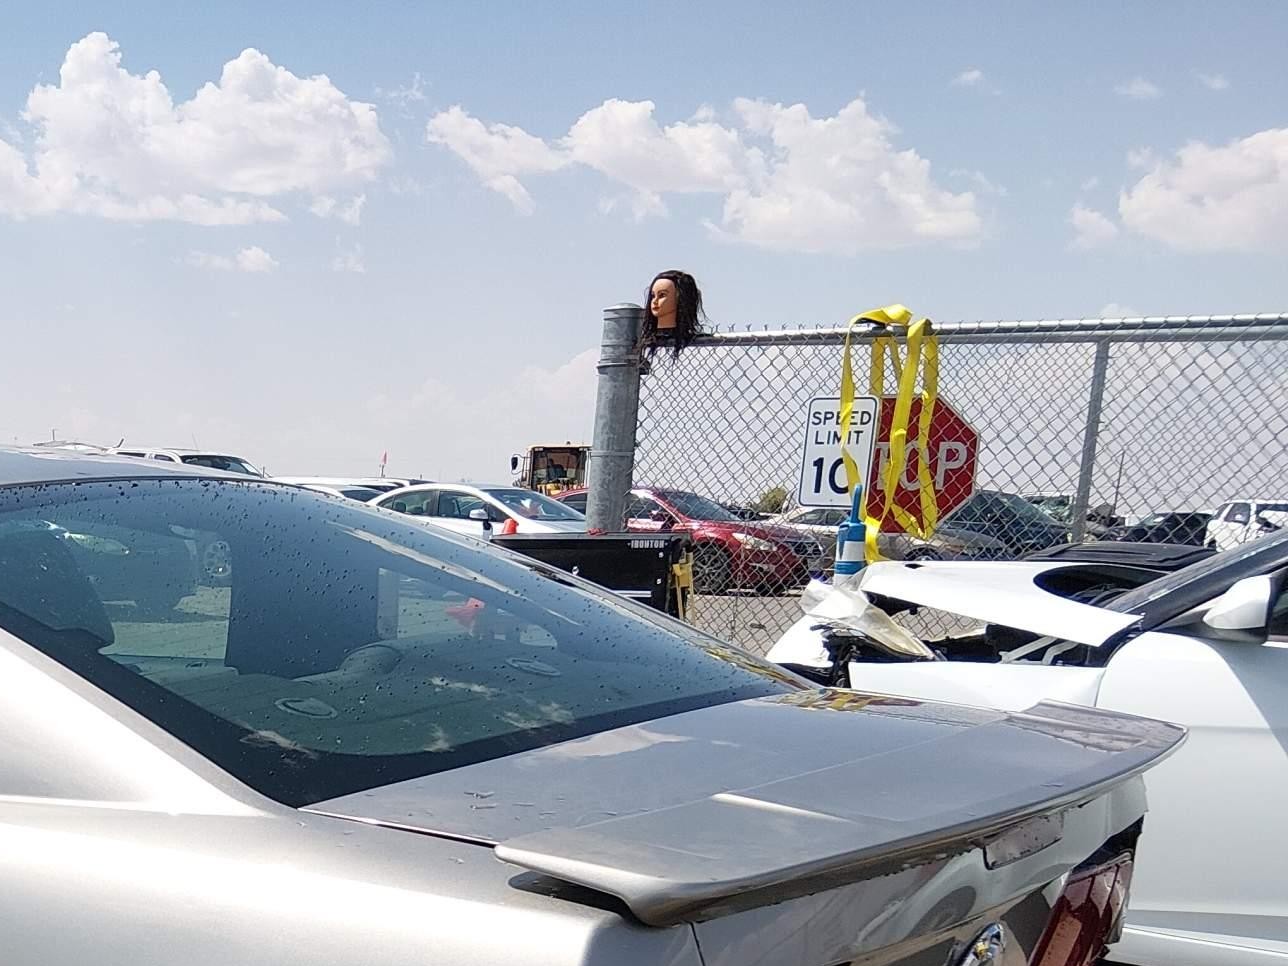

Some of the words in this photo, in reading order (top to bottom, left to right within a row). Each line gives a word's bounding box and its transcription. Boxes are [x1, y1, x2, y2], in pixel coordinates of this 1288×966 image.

[812, 411, 871, 426] SPEED
[815, 430, 864, 445] LIMIT
[875, 441, 967, 491] TOP
